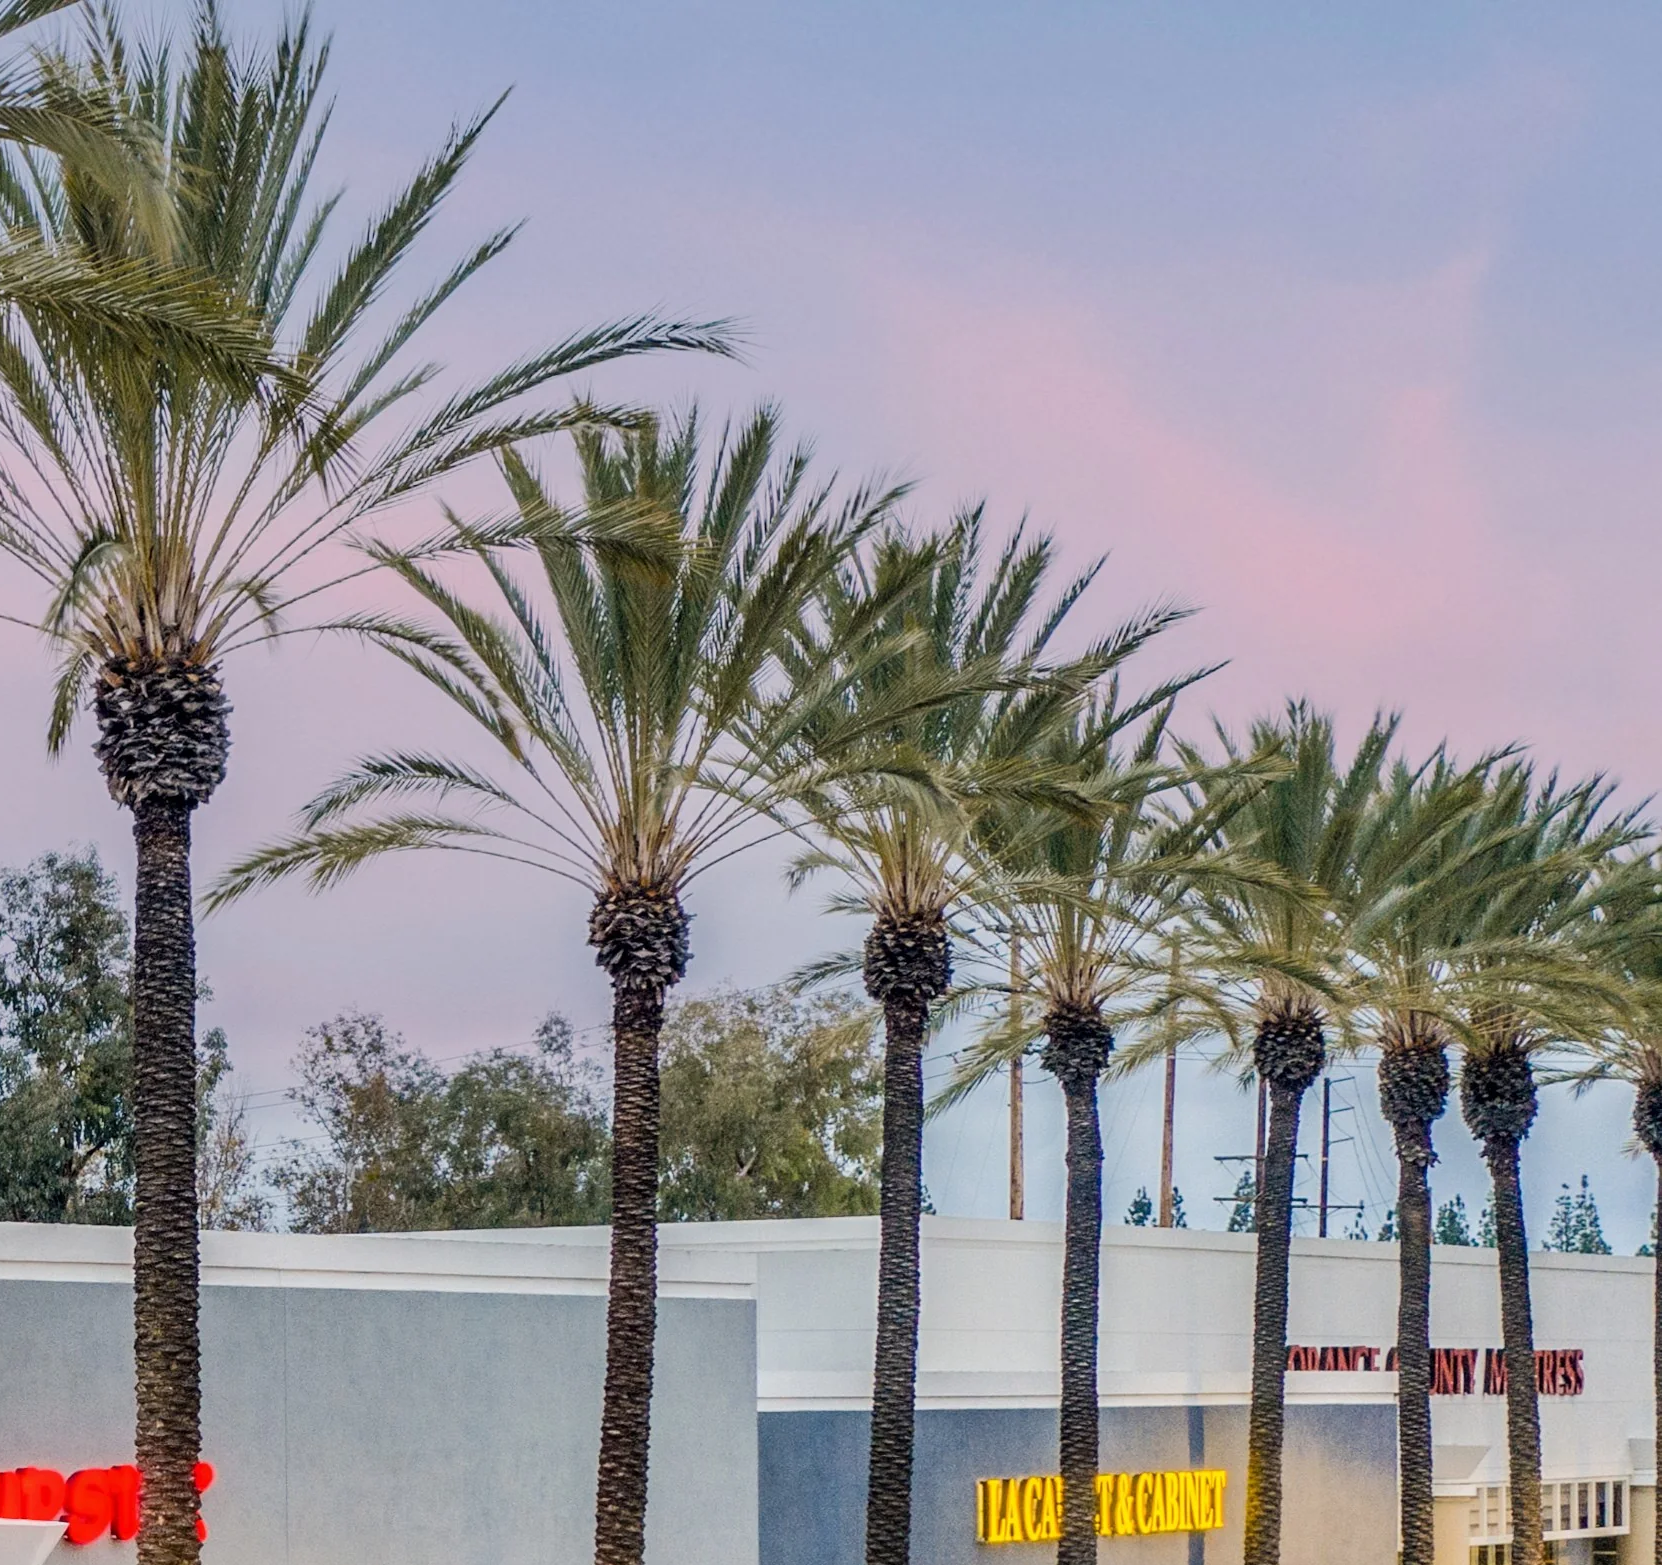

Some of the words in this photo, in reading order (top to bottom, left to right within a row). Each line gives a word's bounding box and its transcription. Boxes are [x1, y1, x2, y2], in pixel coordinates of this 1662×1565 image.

[1483, 1348, 1584, 1396] MTRESS
[978, 1477, 1024, 1544] LA
[1022, 1473, 1114, 1542] CAT
[1134, 1469, 1227, 1535] CABINET
